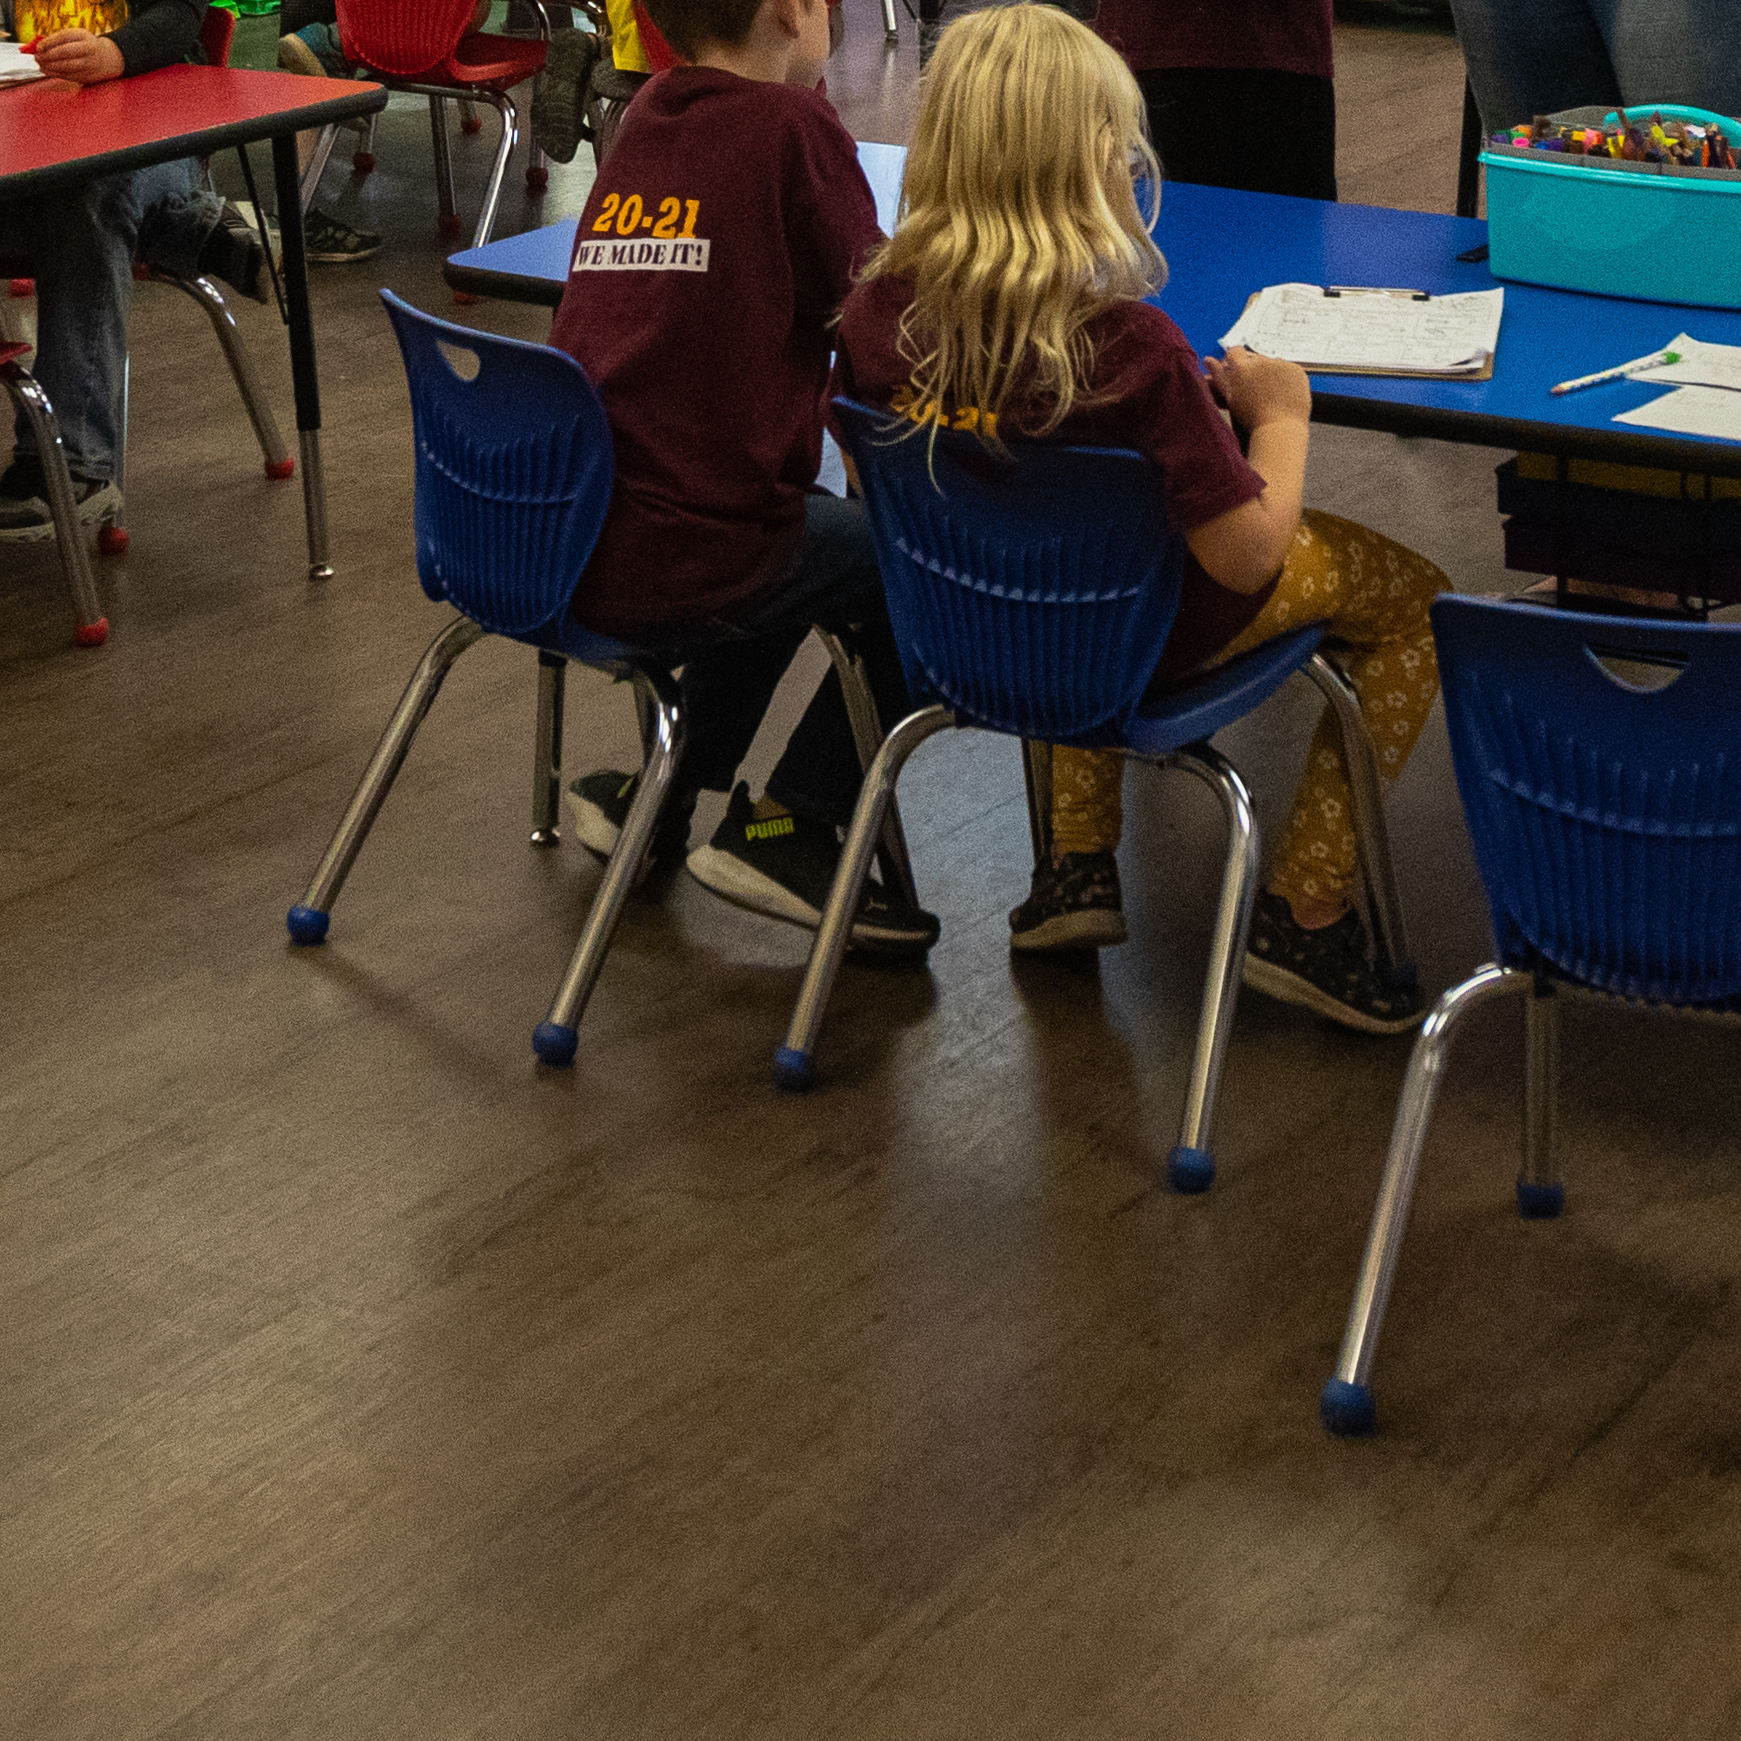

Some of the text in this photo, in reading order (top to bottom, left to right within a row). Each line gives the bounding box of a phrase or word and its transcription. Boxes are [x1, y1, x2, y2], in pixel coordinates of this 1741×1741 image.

[592, 193, 700, 239] 20-21
[579, 244, 703, 266] WE MADE IT!
[746, 818, 795, 841] PUMA
